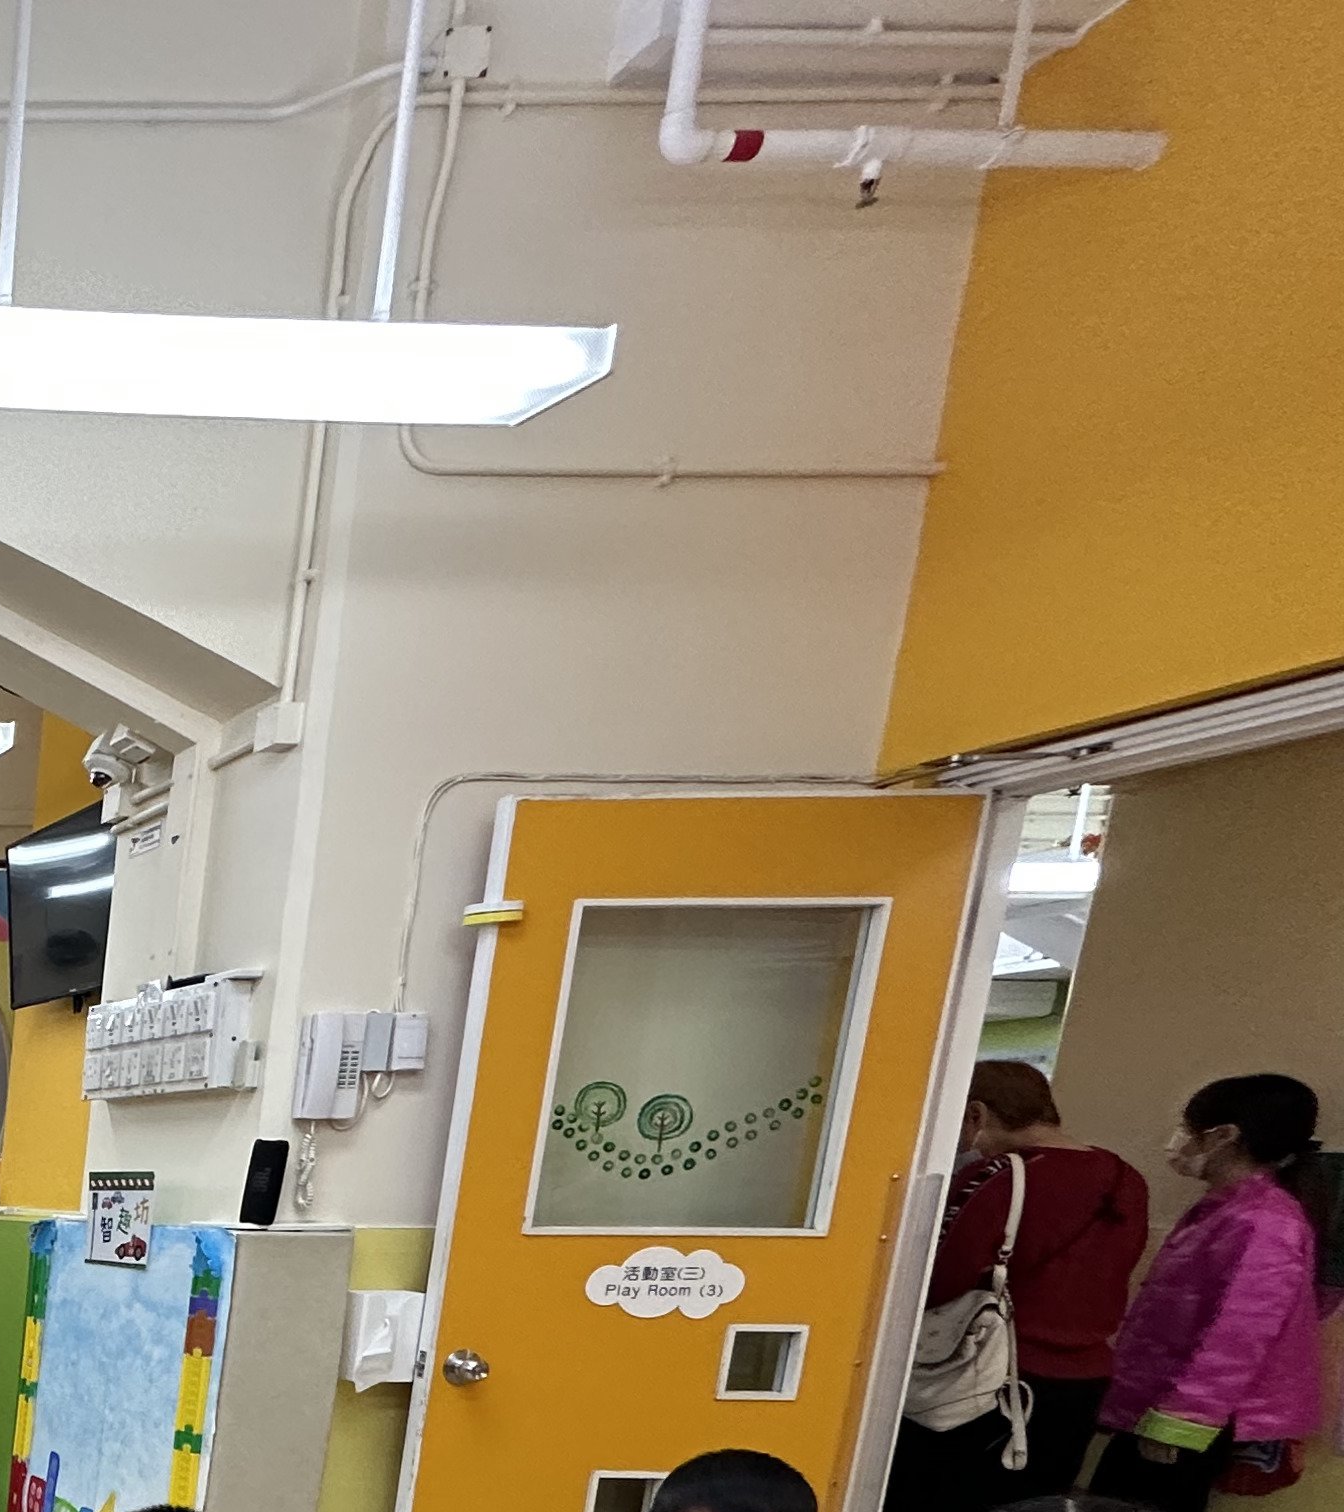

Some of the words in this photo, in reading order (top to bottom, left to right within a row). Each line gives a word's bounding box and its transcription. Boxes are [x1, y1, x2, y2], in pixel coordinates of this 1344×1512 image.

[100, 1198, 149, 1243] 智趣坊
[605, 1284, 640, 1299] Play
[648, 1284, 691, 1297] Room
[699, 1284, 723, 1298] (3)
